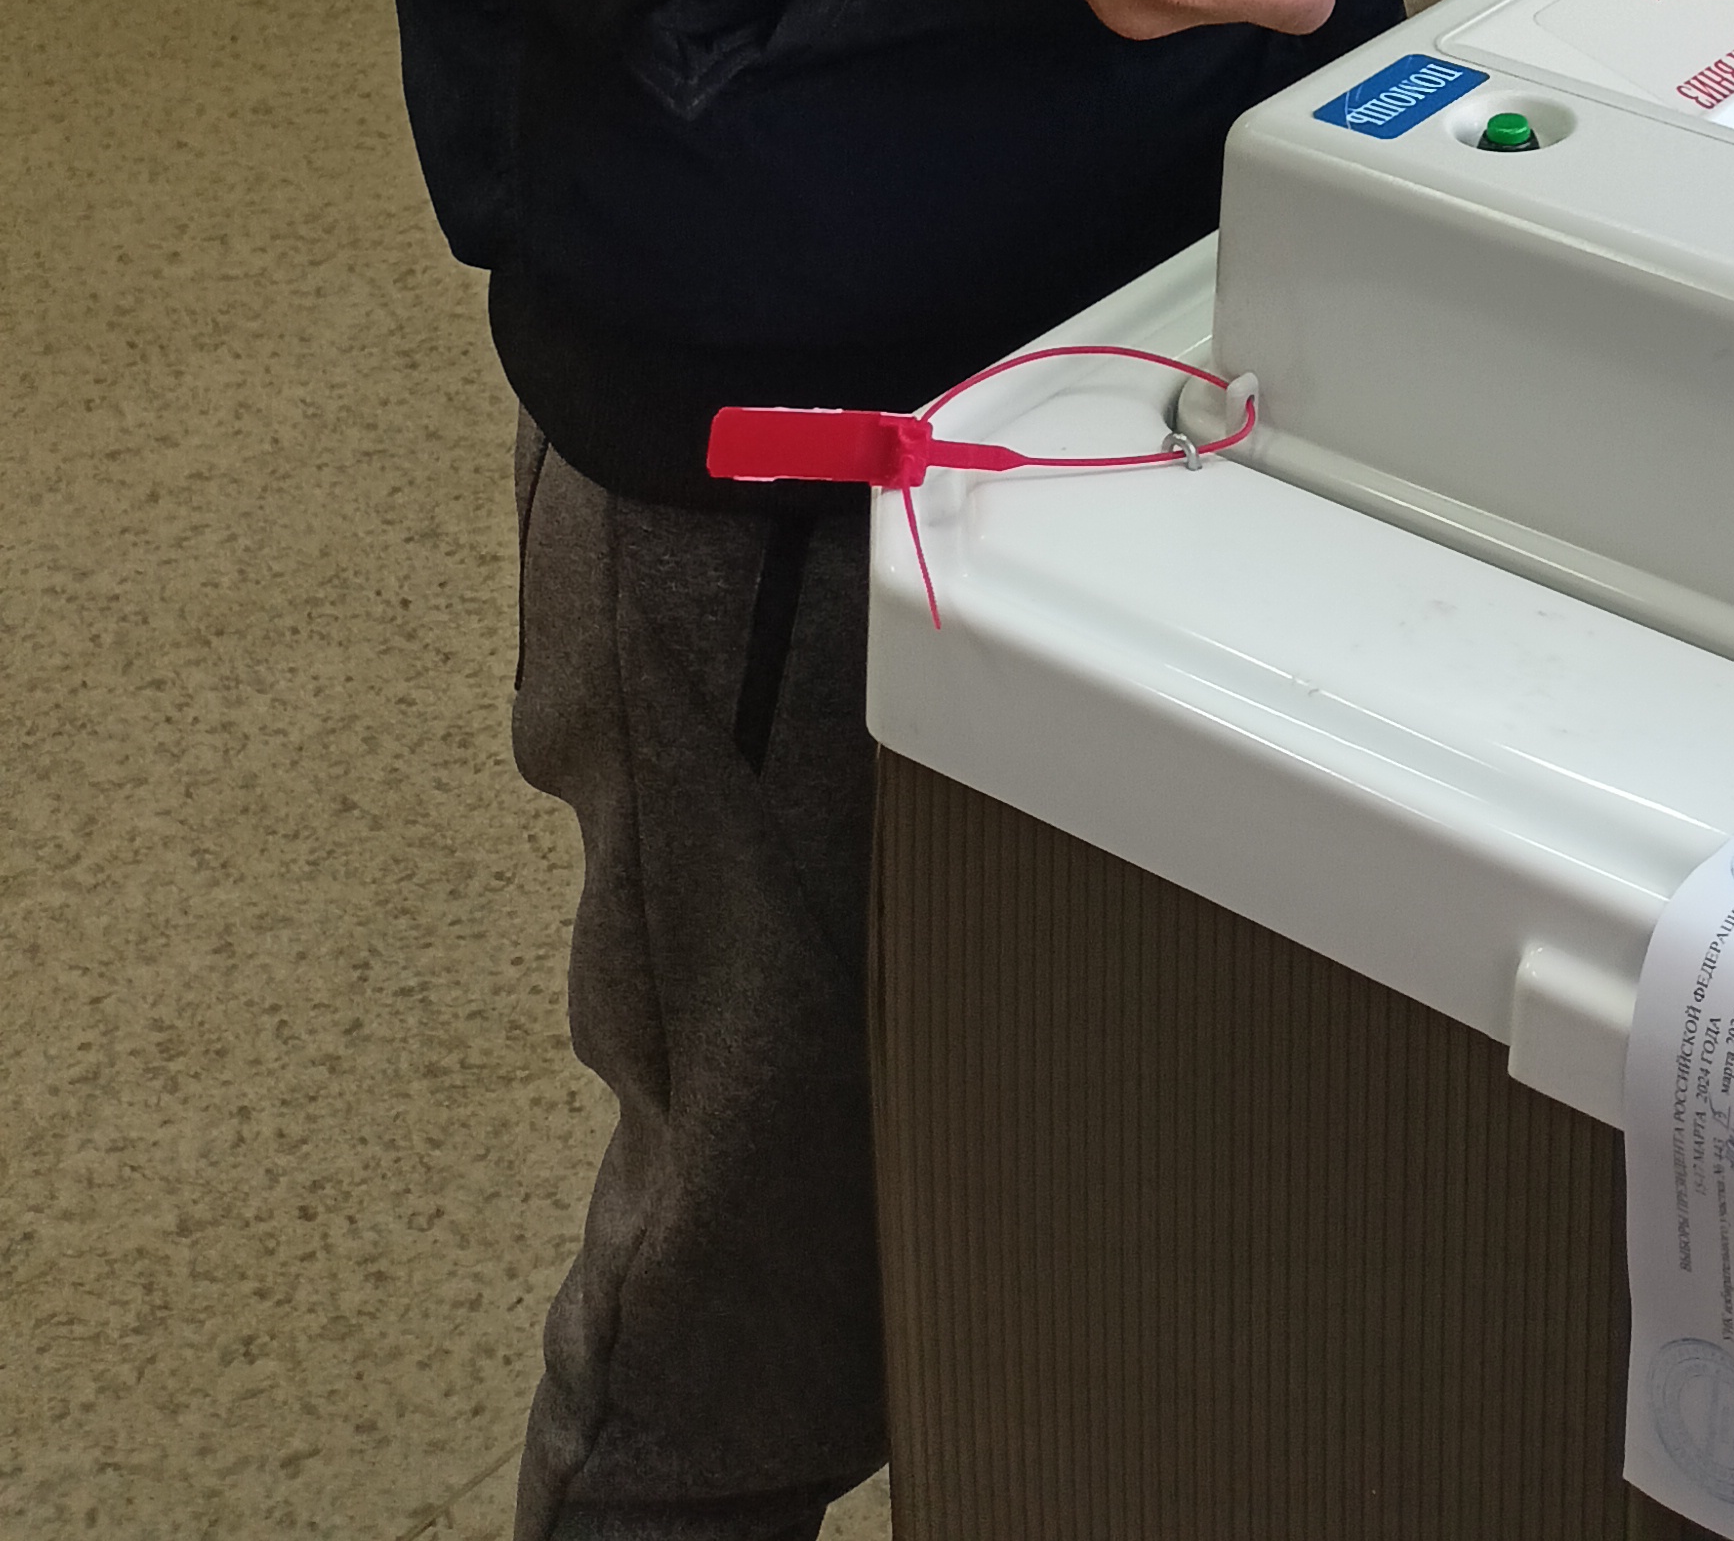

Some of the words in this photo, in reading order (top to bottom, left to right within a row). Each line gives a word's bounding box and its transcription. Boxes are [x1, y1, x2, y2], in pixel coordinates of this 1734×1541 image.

[1346, 63, 1463, 125] ПОМОЩЬ
[1674, 1005, 1701, 1124] РОССИЙСКОЙ
[1700, 1017, 1722, 1065] ГОДА
[1696, 1067, 1711, 1104] 2024
[1693, 1111, 1706, 1161] МАРТА
